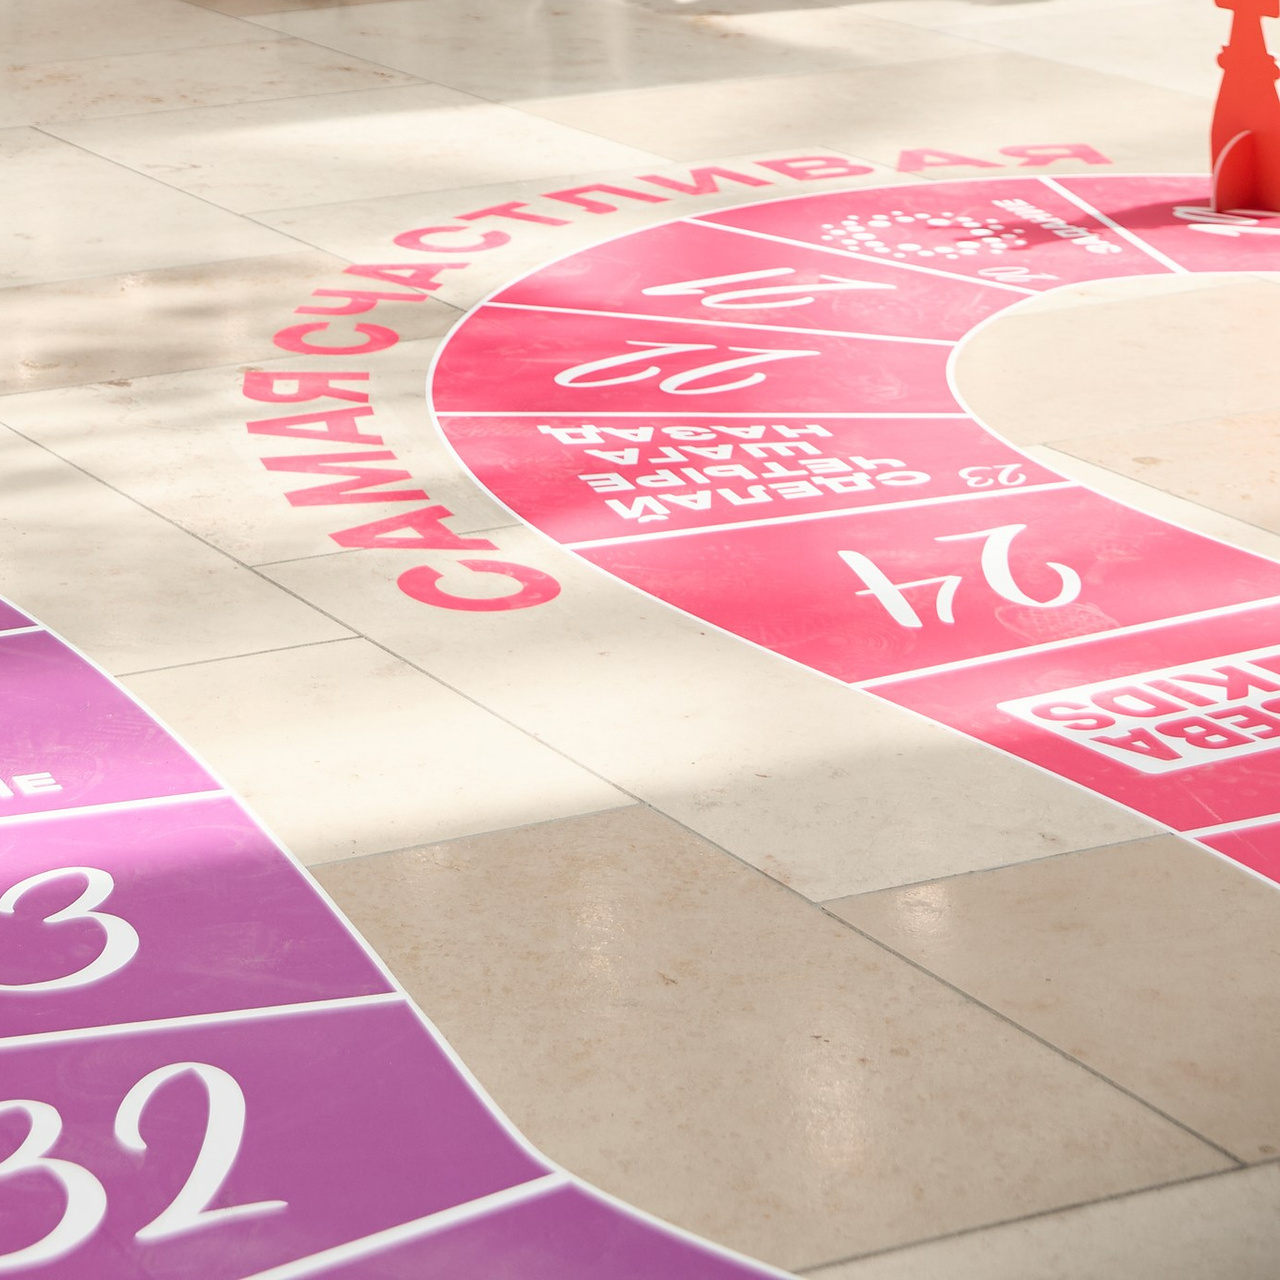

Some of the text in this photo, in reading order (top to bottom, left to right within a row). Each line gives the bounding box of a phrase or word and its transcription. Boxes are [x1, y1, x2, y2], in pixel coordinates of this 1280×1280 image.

[642, 266, 897, 310] 21
[242, 143, 1114, 612] САМАЯ СЧАСТЛИВАЯ
[554, 340, 821, 395] 22
[536, 424, 833, 446] НАЗАД
[584, 441, 821, 468] ШАГА
[577, 454, 906, 496] ЧЕТЫРЕ
[607, 469, 932, 522] СДЕЛАЙ
[957, 463, 1027, 488] 23
[836, 523, 1082, 628] 24
[1030, 664, 1280, 731] KIDS
